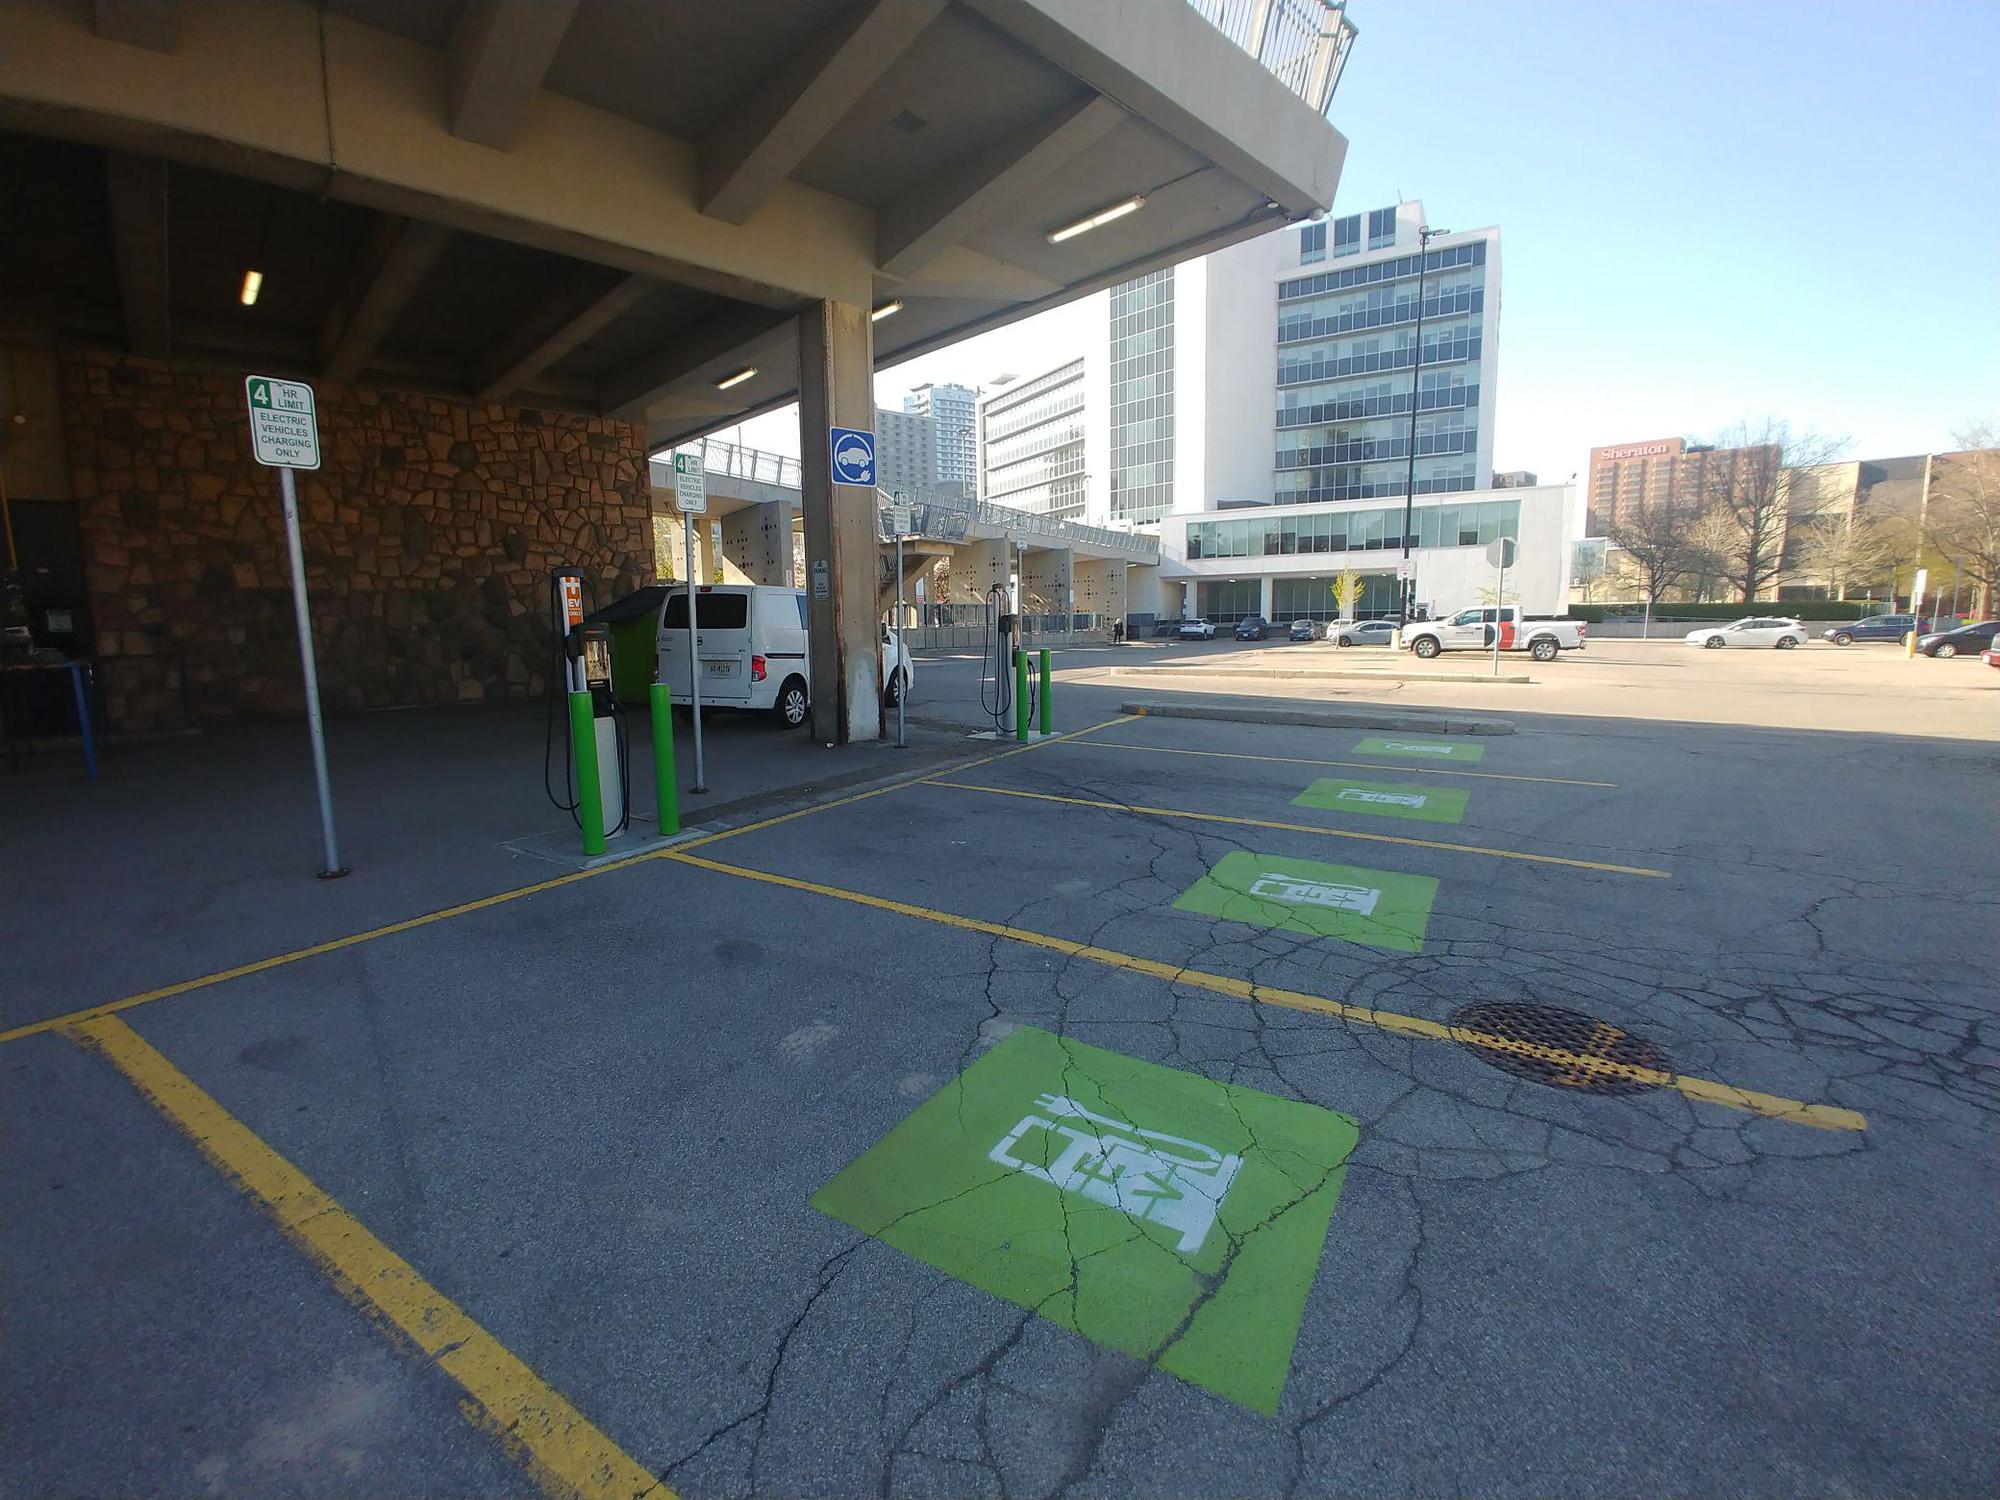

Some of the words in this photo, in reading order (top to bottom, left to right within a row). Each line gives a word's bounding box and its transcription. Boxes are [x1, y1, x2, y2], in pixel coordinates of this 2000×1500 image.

[254, 384, 269, 405] 4
[283, 388, 298, 399] HR
[278, 399, 304, 411] LIMIT
[260, 412, 307, 426] ELECTRIC
[261, 424, 308, 437] VEHICLES
[261, 435, 312, 448] CHARGING
[275, 448, 300, 458] ONLY
[1600, 444, 1668, 460] Sheraton
[677, 457, 684, 471] 4
[568, 599, 580, 608] EV
